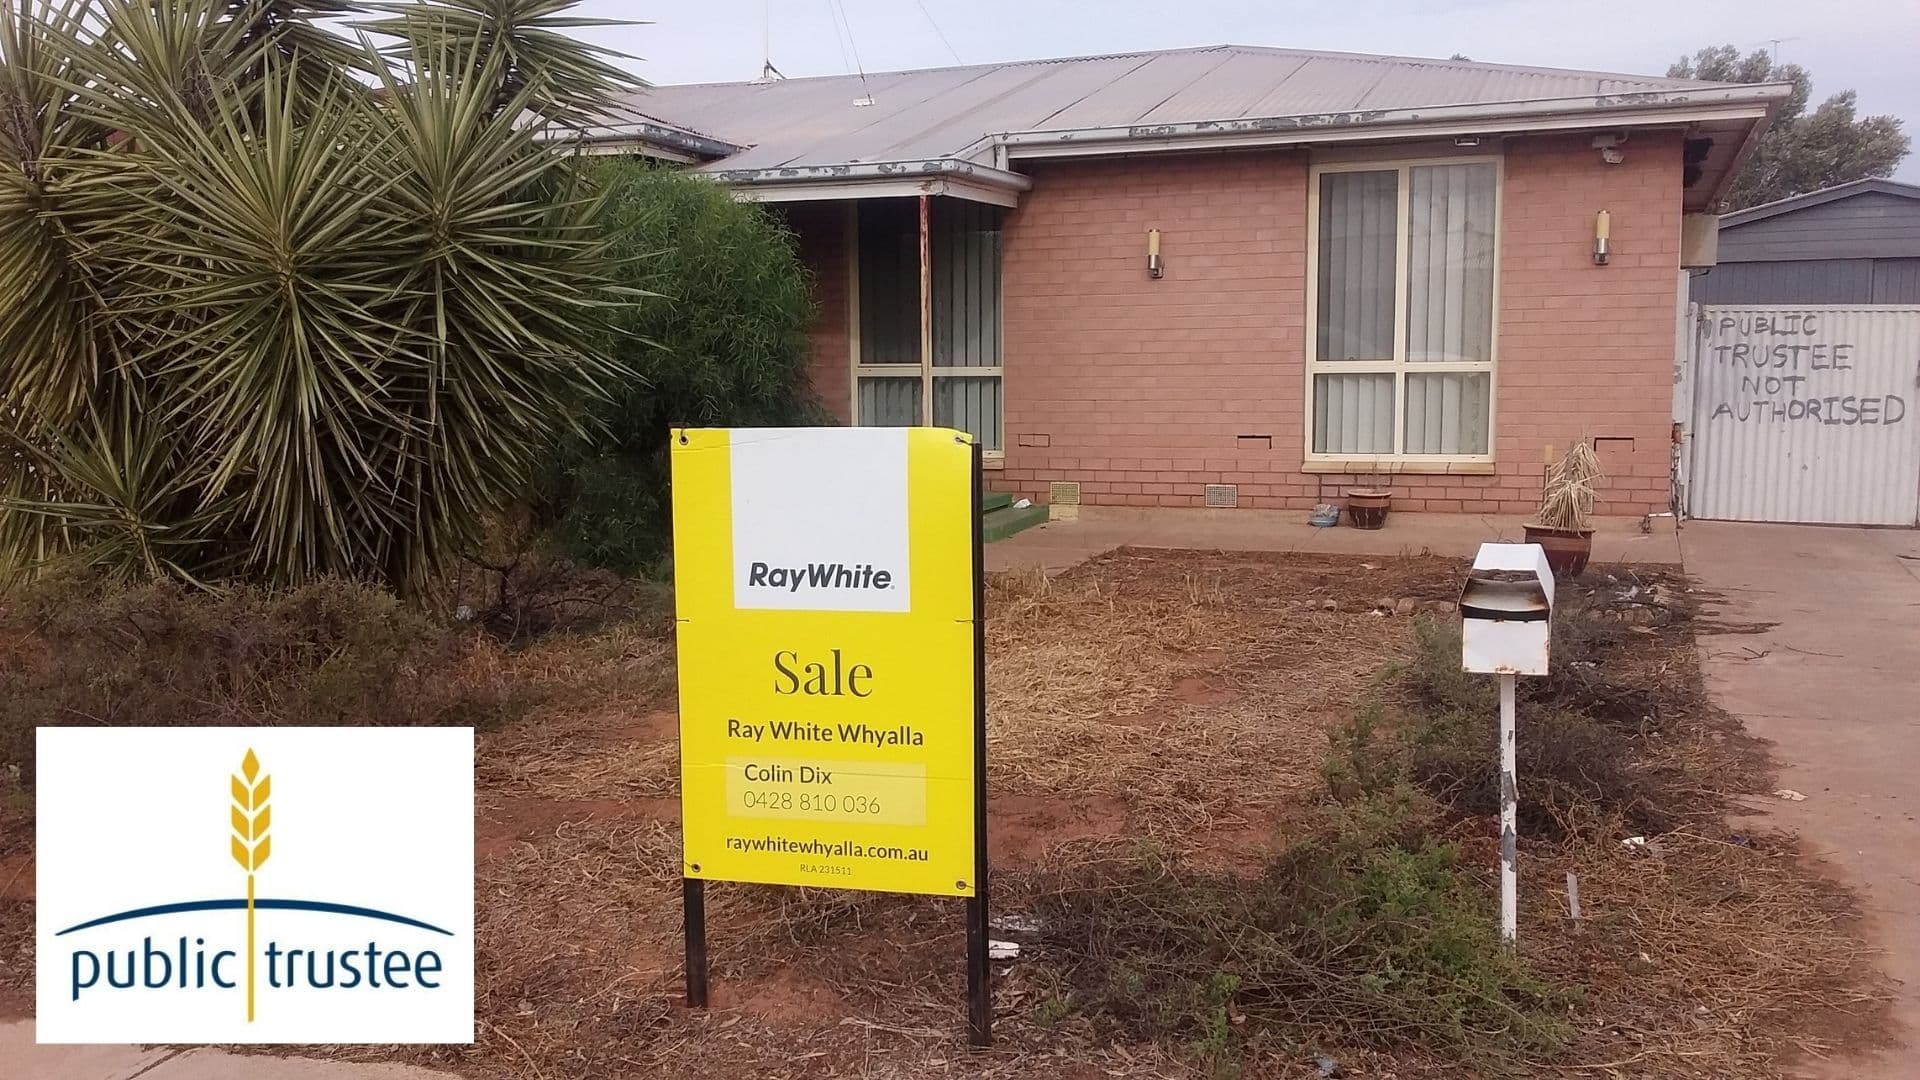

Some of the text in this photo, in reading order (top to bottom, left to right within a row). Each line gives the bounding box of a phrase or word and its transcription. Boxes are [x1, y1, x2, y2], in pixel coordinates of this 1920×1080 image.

[1719, 315, 1817, 337] PUBLIC
[1714, 344, 1854, 370] TRUSTEE
[1741, 376, 1806, 396] NOT
[1711, 394, 1906, 426] AUTHORISED
[774, 649, 873, 697] Sale
[727, 719, 924, 748] Ray White Whyalla
[744, 764, 833, 785] Colin Dix
[743, 791, 881, 815] 0428 810 036
[726, 835, 929, 862] raywhitewhyalla.com.au
[800, 863, 851, 876] RLA 231511
